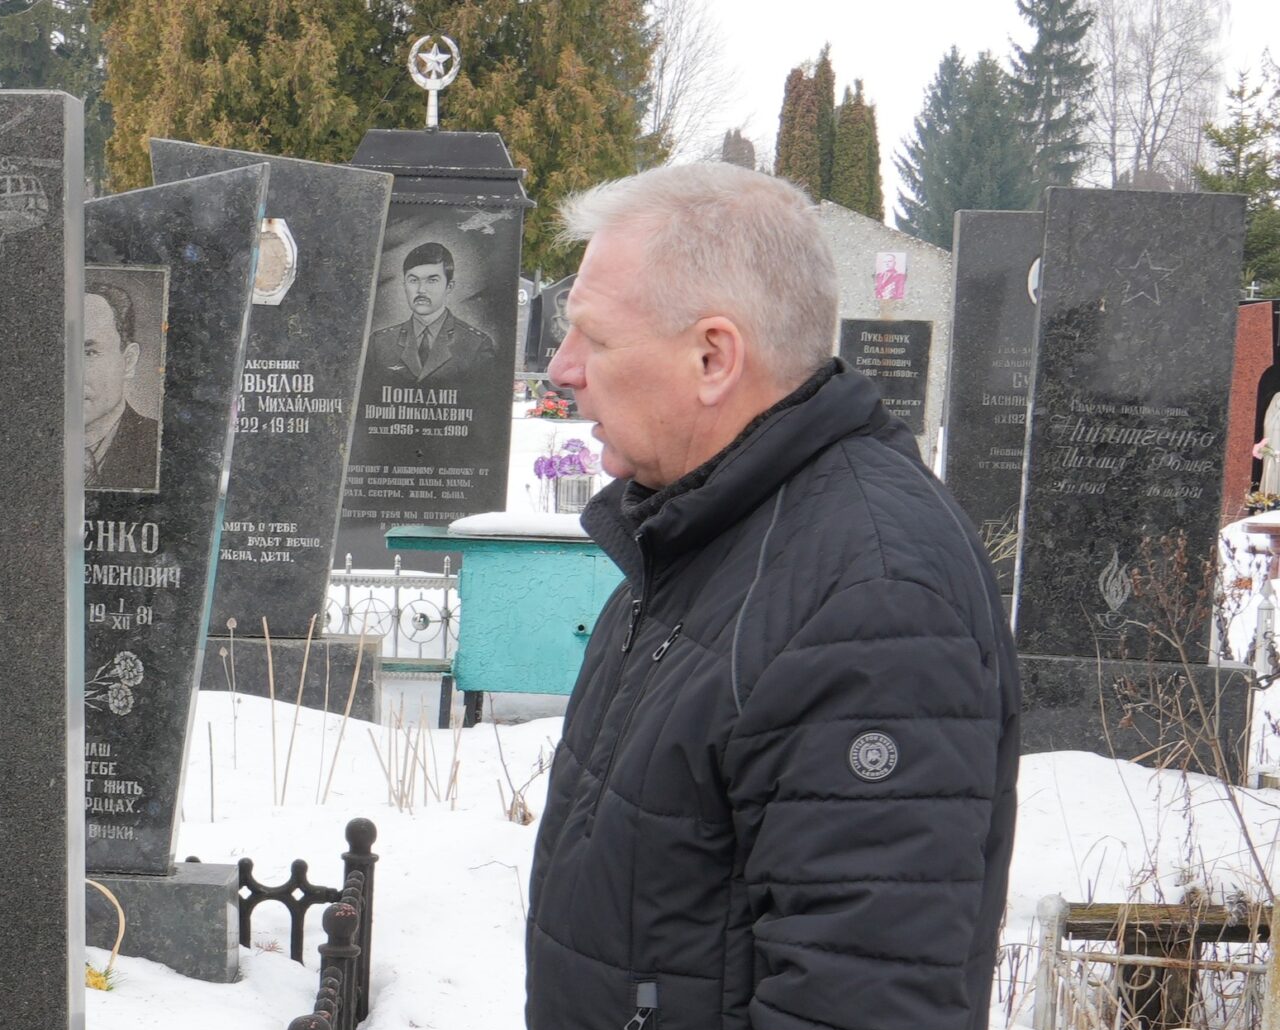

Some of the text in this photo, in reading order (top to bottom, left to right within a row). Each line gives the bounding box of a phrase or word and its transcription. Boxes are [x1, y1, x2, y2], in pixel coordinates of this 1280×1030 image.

[240, 374, 314, 393] ВЬЯЛОВ
[258, 394, 342, 413] МИХАЙЛОВИЧ
[382, 386, 458, 406] ПОПАДИН
[365, 404, 473, 421] ЮРИЙ НИКОЛАЕВИЧ
[258, 523, 265, 532] О
[269, 523, 298, 532] ТЕБЕ
[247, 536, 281, 548] БУДЕТ
[104, 780, 143, 795] ЖИТЬ
